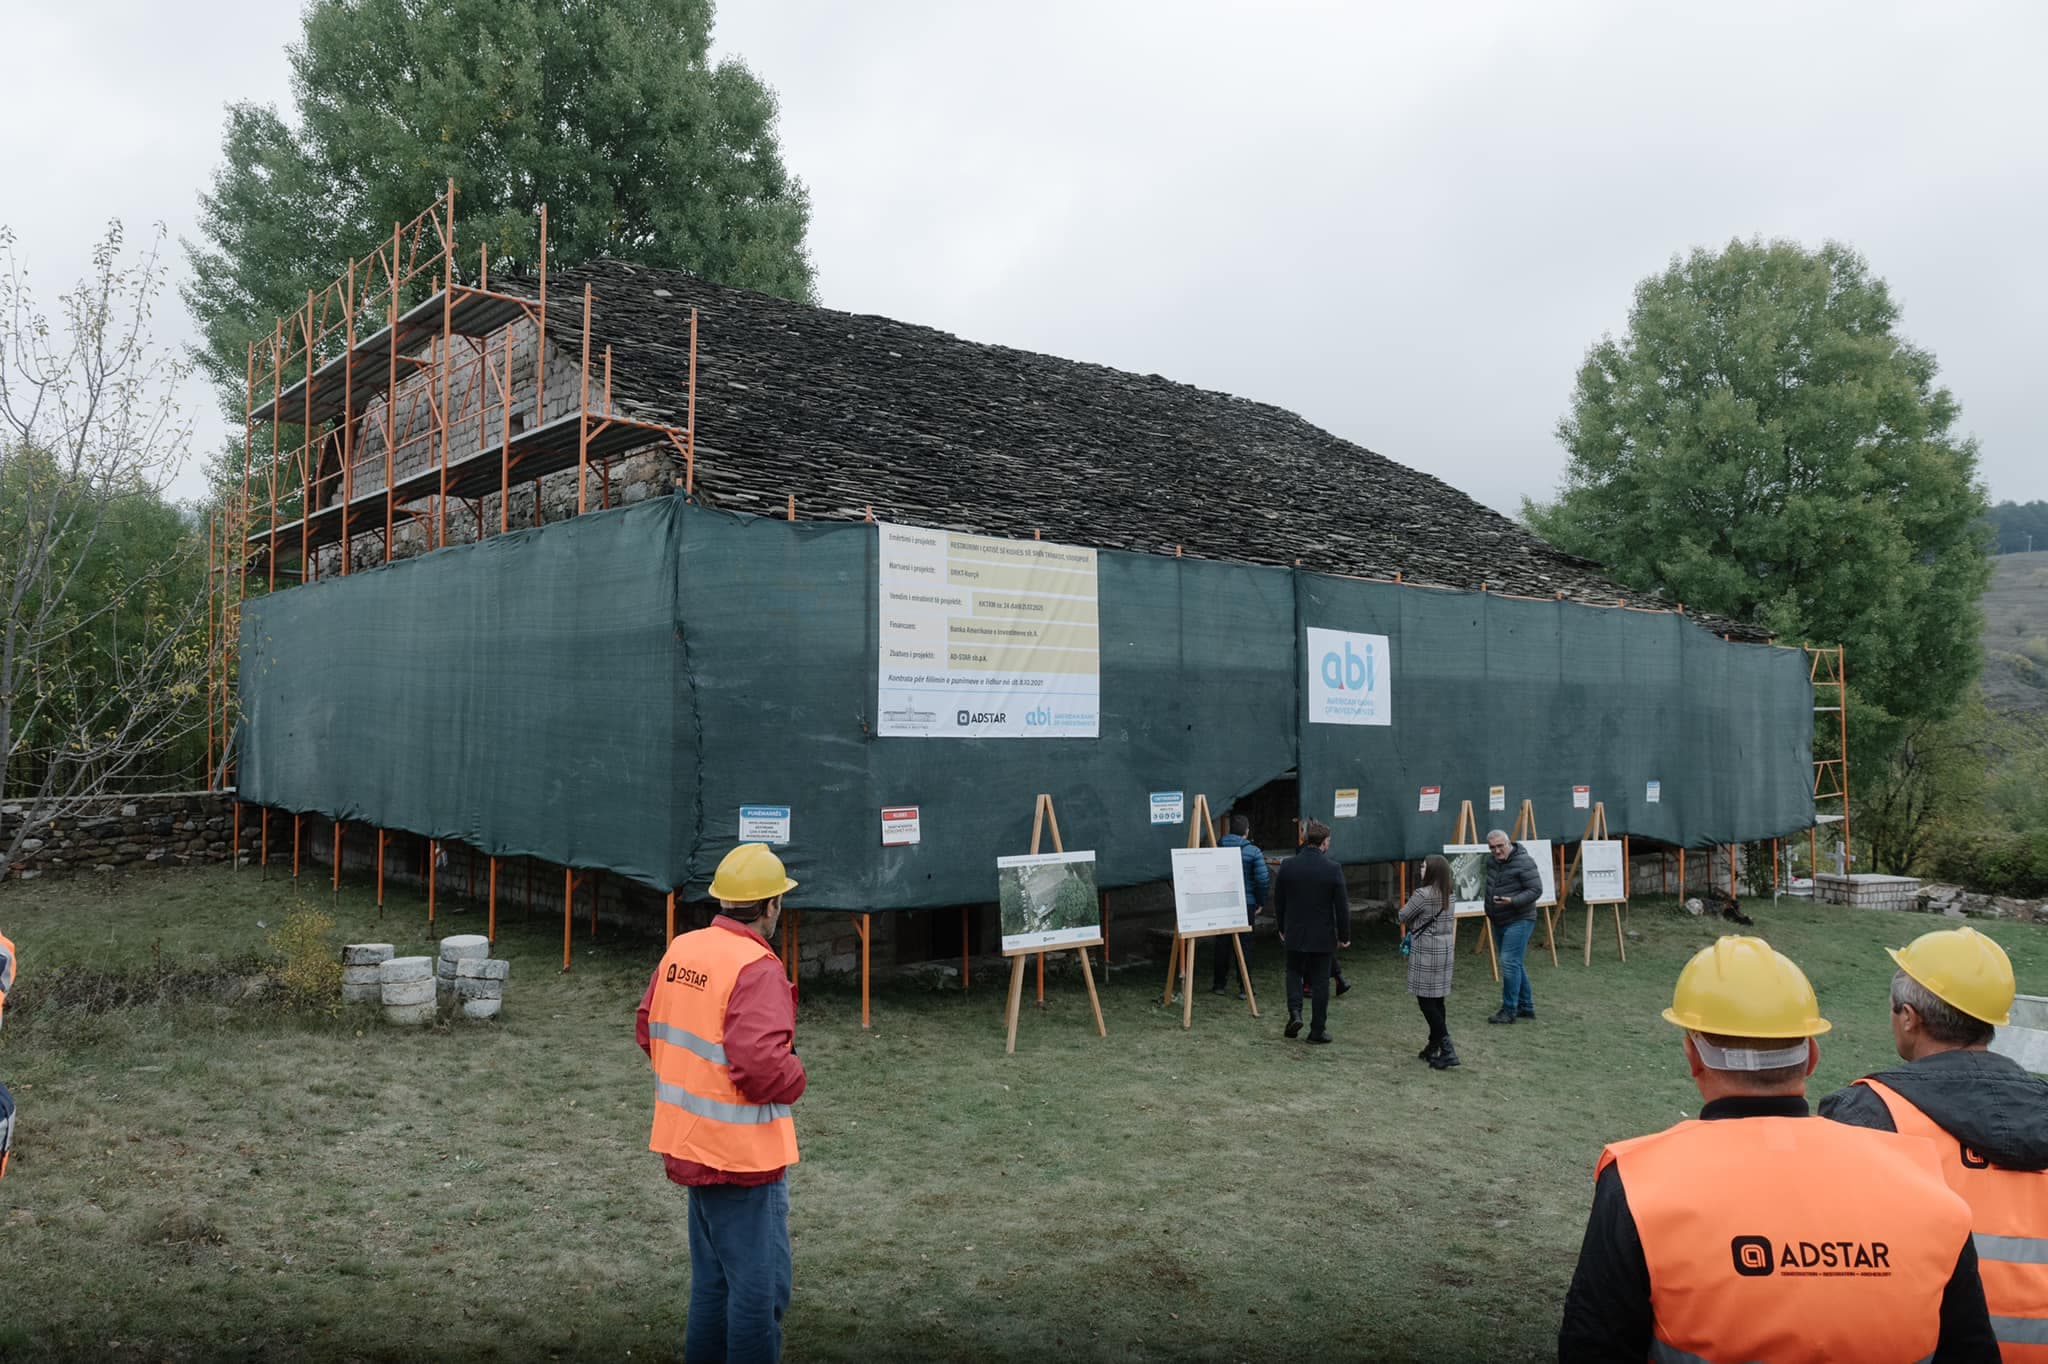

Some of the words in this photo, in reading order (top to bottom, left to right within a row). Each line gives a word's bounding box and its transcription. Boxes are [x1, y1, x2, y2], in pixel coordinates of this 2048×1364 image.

[1321, 641, 1375, 692] abi
[971, 712, 1007, 724] ADSTAR
[1024, 705, 1052, 727] abi
[677, 967, 708, 988] DSTAR
[1780, 1241, 1890, 1268] ADSTAR
